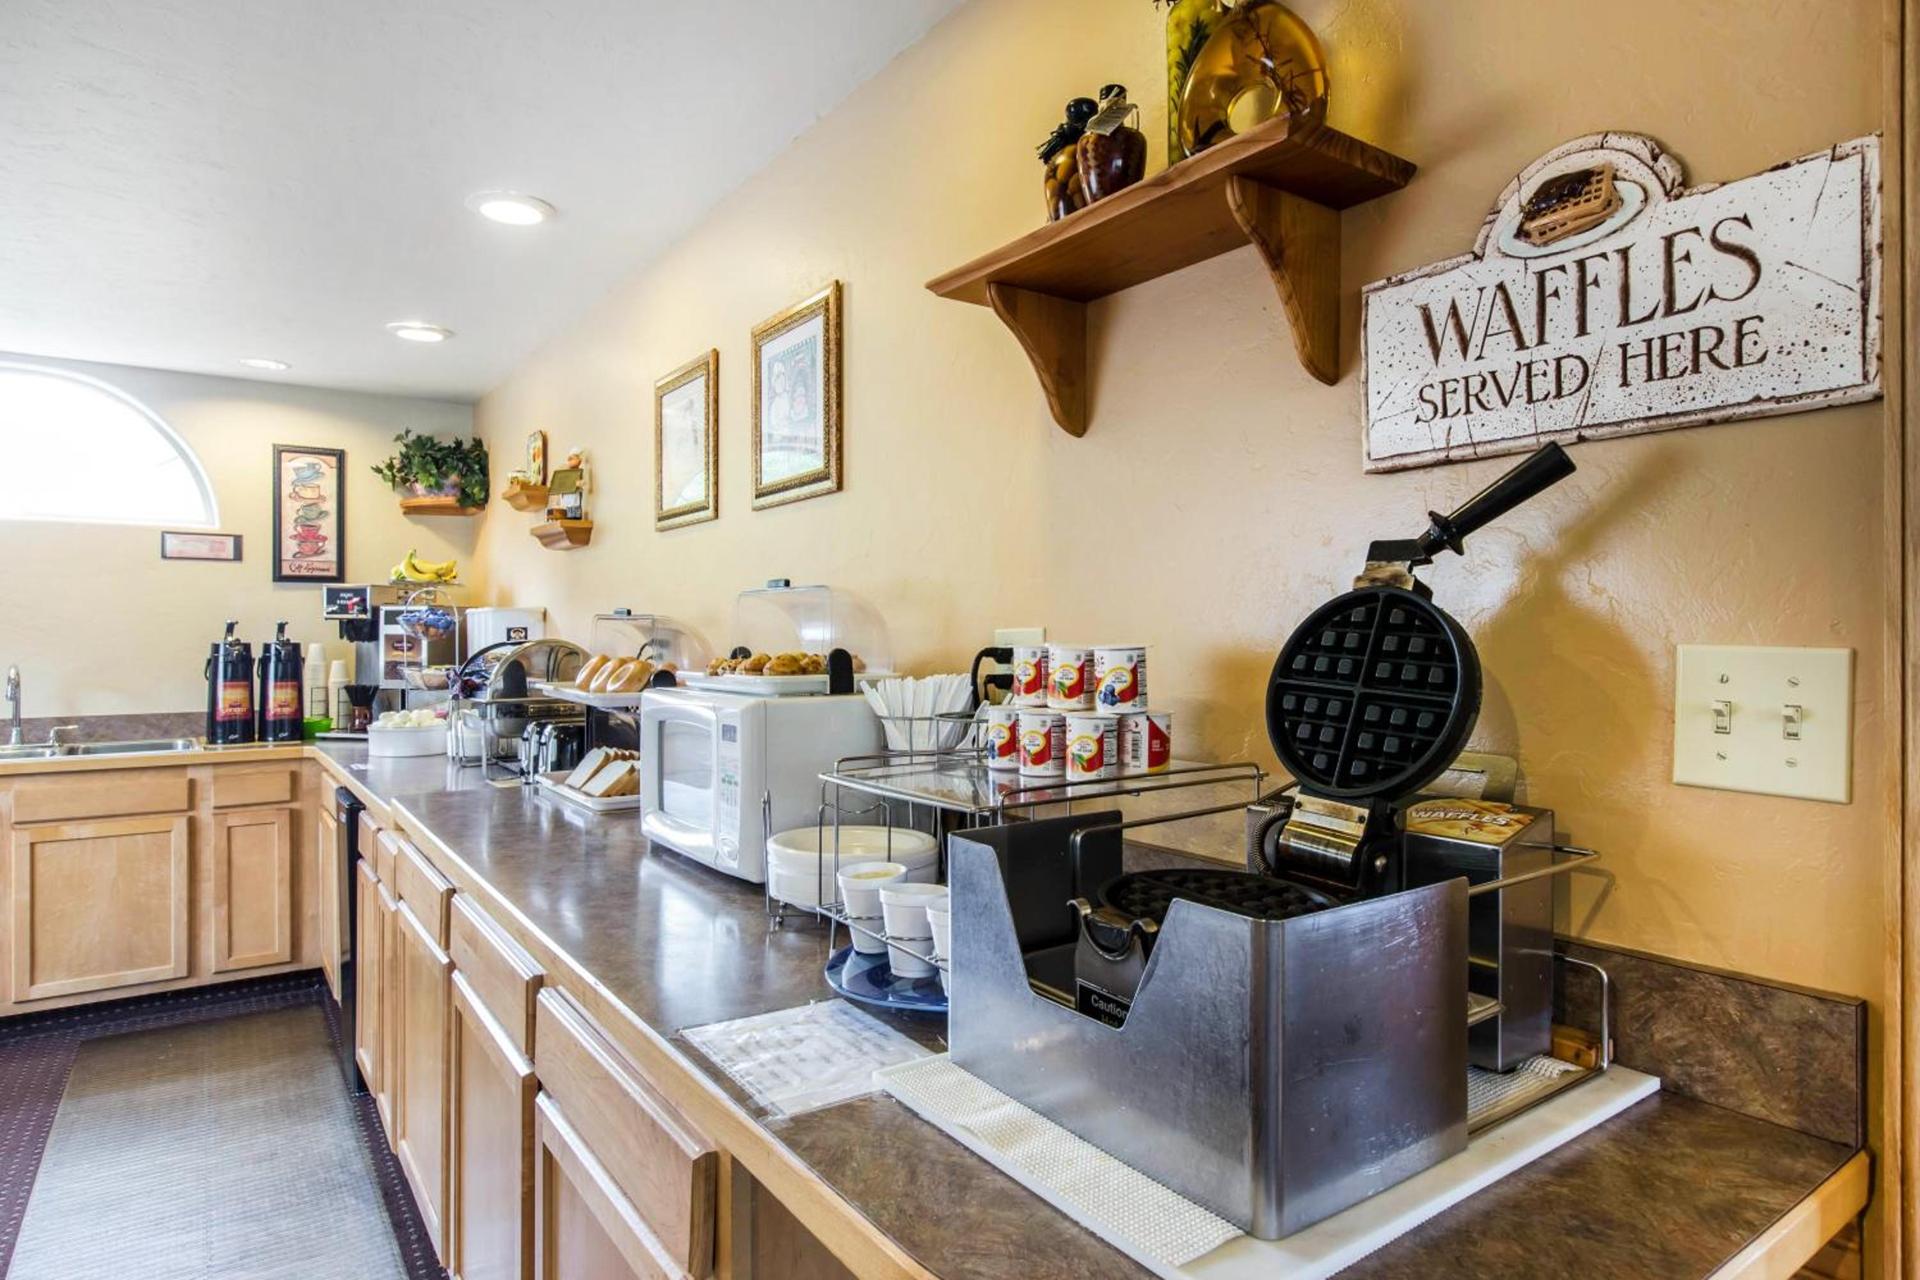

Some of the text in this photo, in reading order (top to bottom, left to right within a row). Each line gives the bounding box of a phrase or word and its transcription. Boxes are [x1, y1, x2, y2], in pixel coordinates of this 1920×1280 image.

[1418, 213, 1762, 367] WAFFLES
[1415, 316, 1768, 424] SERVED HERE
[1413, 810, 1510, 826] WAFFLES
